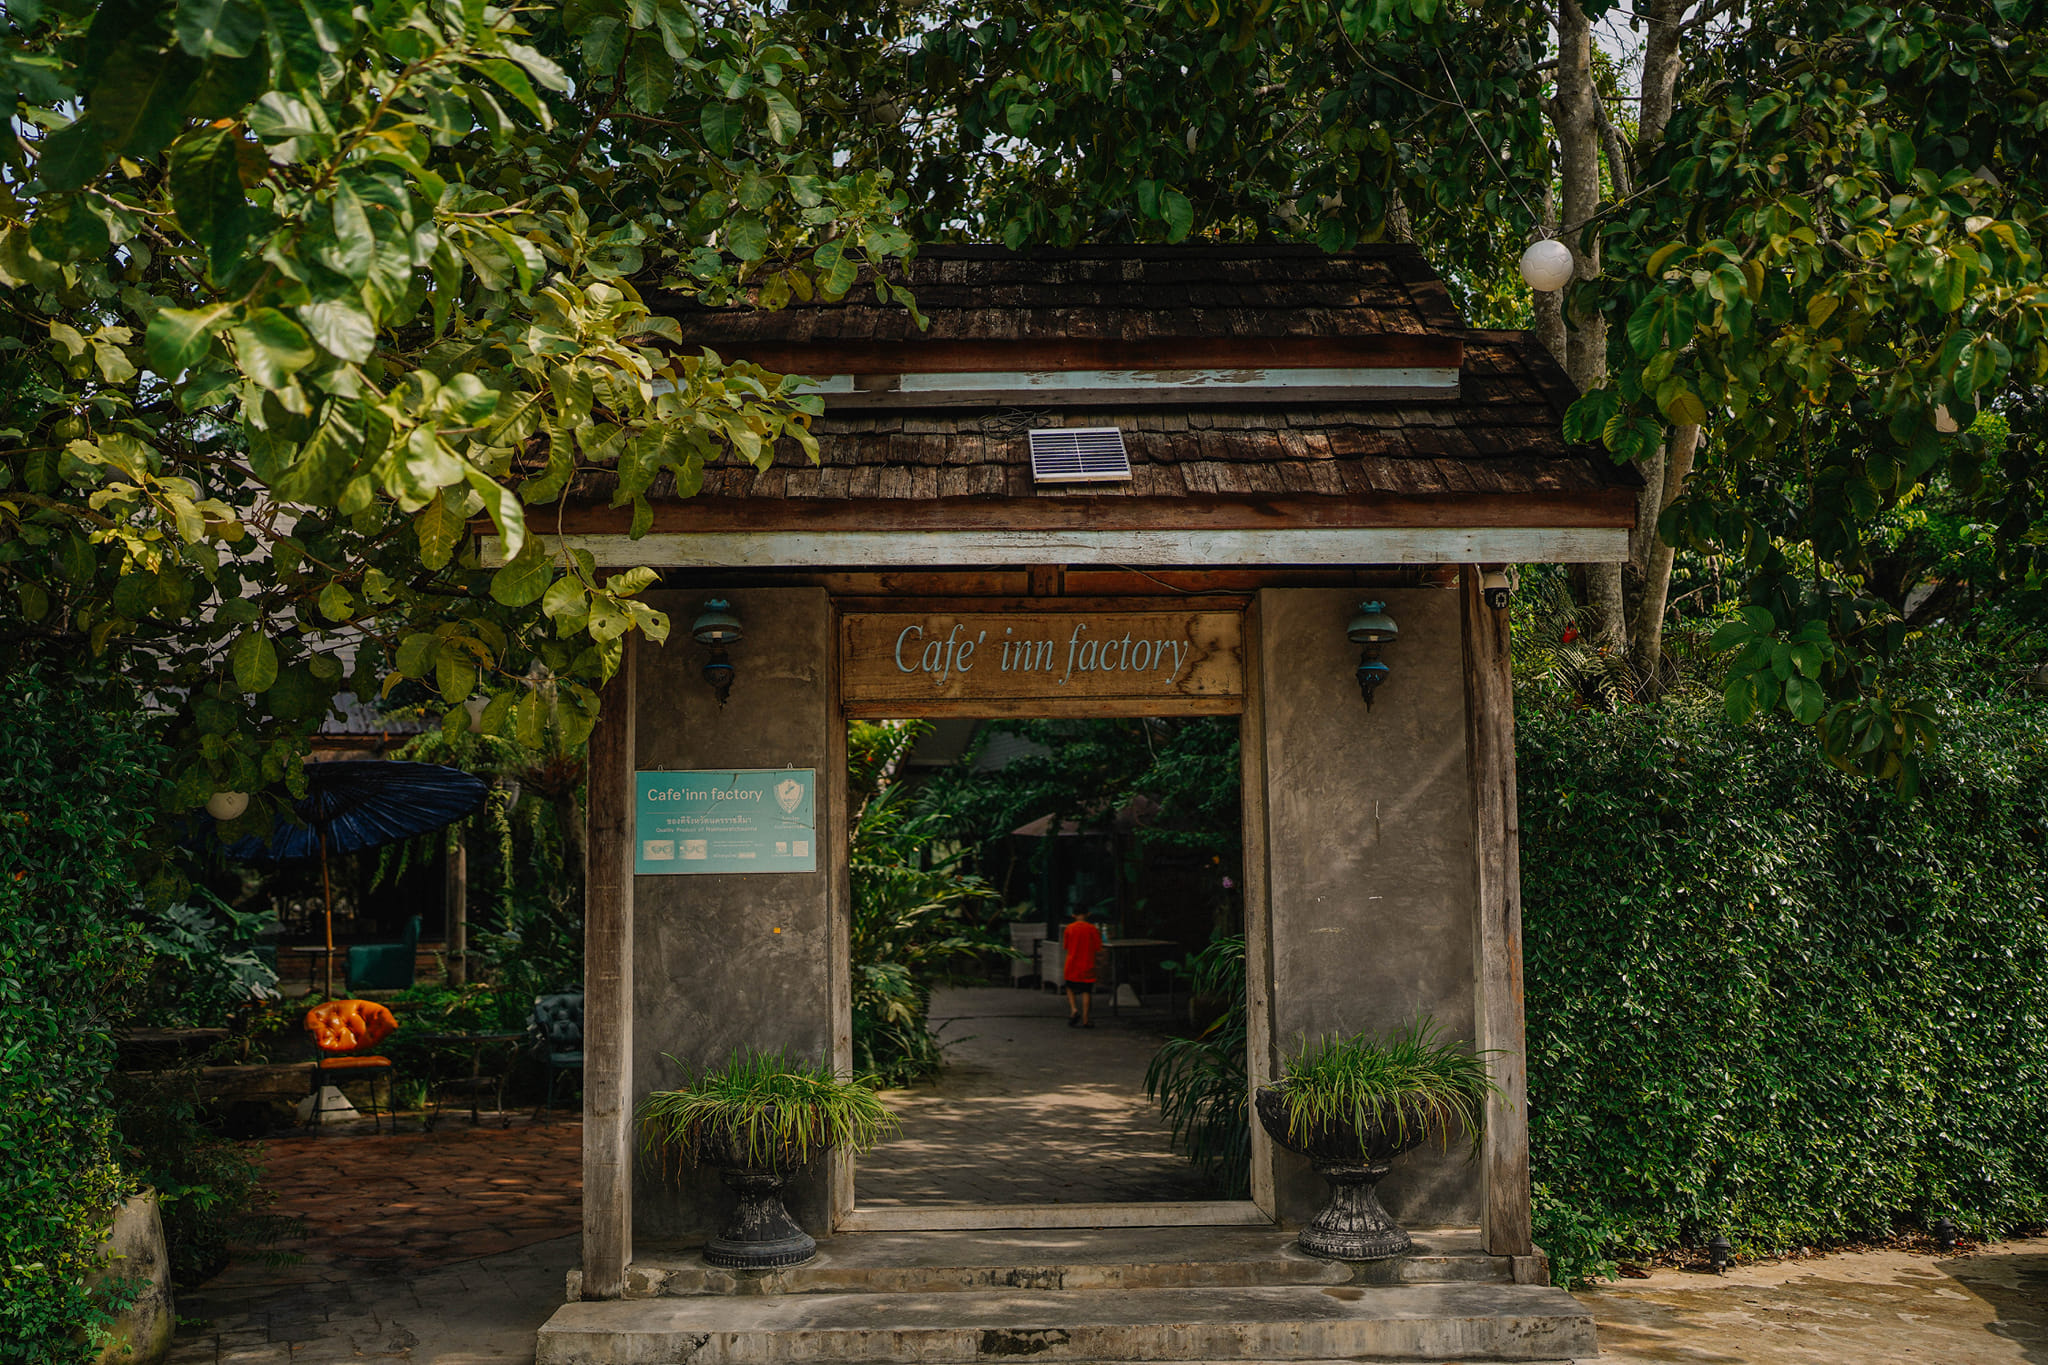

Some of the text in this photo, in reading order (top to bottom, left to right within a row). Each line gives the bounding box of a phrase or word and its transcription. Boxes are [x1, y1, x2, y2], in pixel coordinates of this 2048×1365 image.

[895, 623, 1188, 685] Cafe' inn factory
[648, 788, 763, 802] Cafe'inn factory
